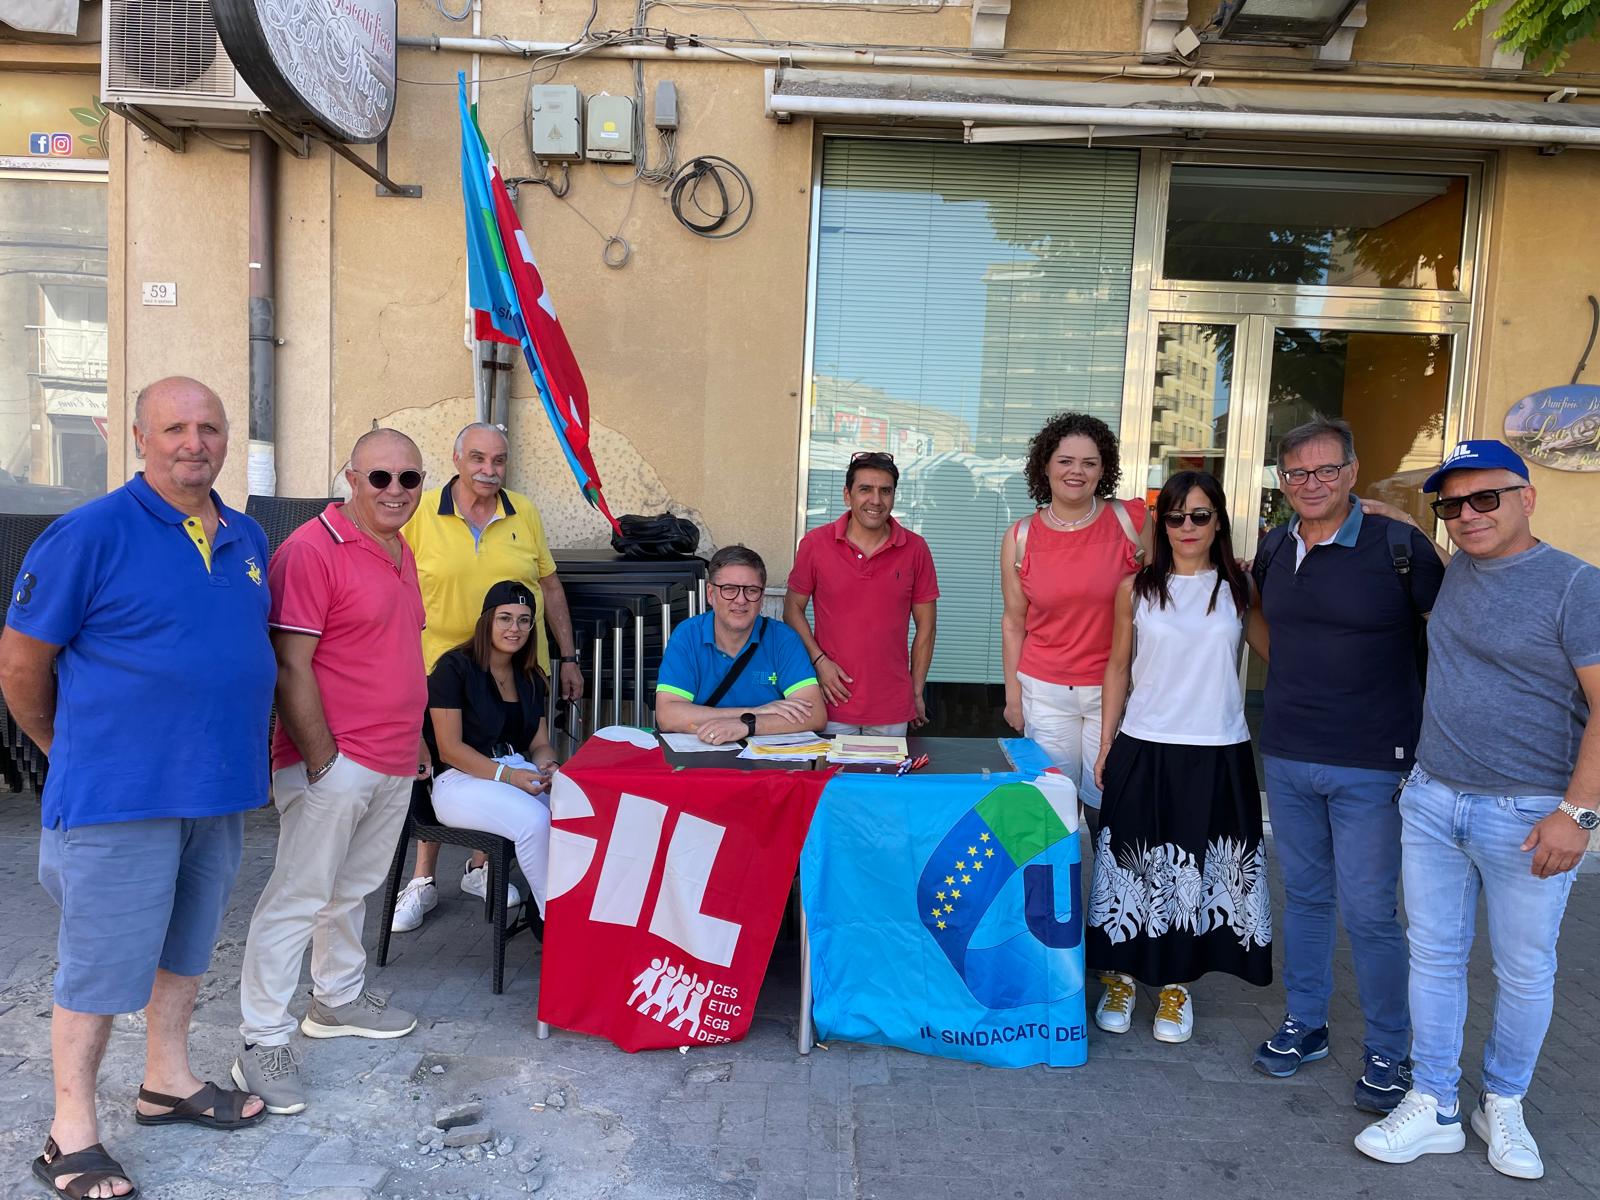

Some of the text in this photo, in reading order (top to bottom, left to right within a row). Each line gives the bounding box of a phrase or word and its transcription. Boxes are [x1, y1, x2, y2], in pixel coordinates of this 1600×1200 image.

[323, 15, 388, 118] Spiga
[328, 94, 371, 132] Romano
[151, 284, 167, 298] 59
[1446, 444, 1471, 464] IL
[16, 571, 38, 606] 3
[713, 983, 739, 999] CES
[708, 999, 742, 1017] ETUC
[703, 1014, 730, 1031] EGB
[920, 1026, 937, 1040] IL
[941, 1023, 1050, 1047] SINDACATO
